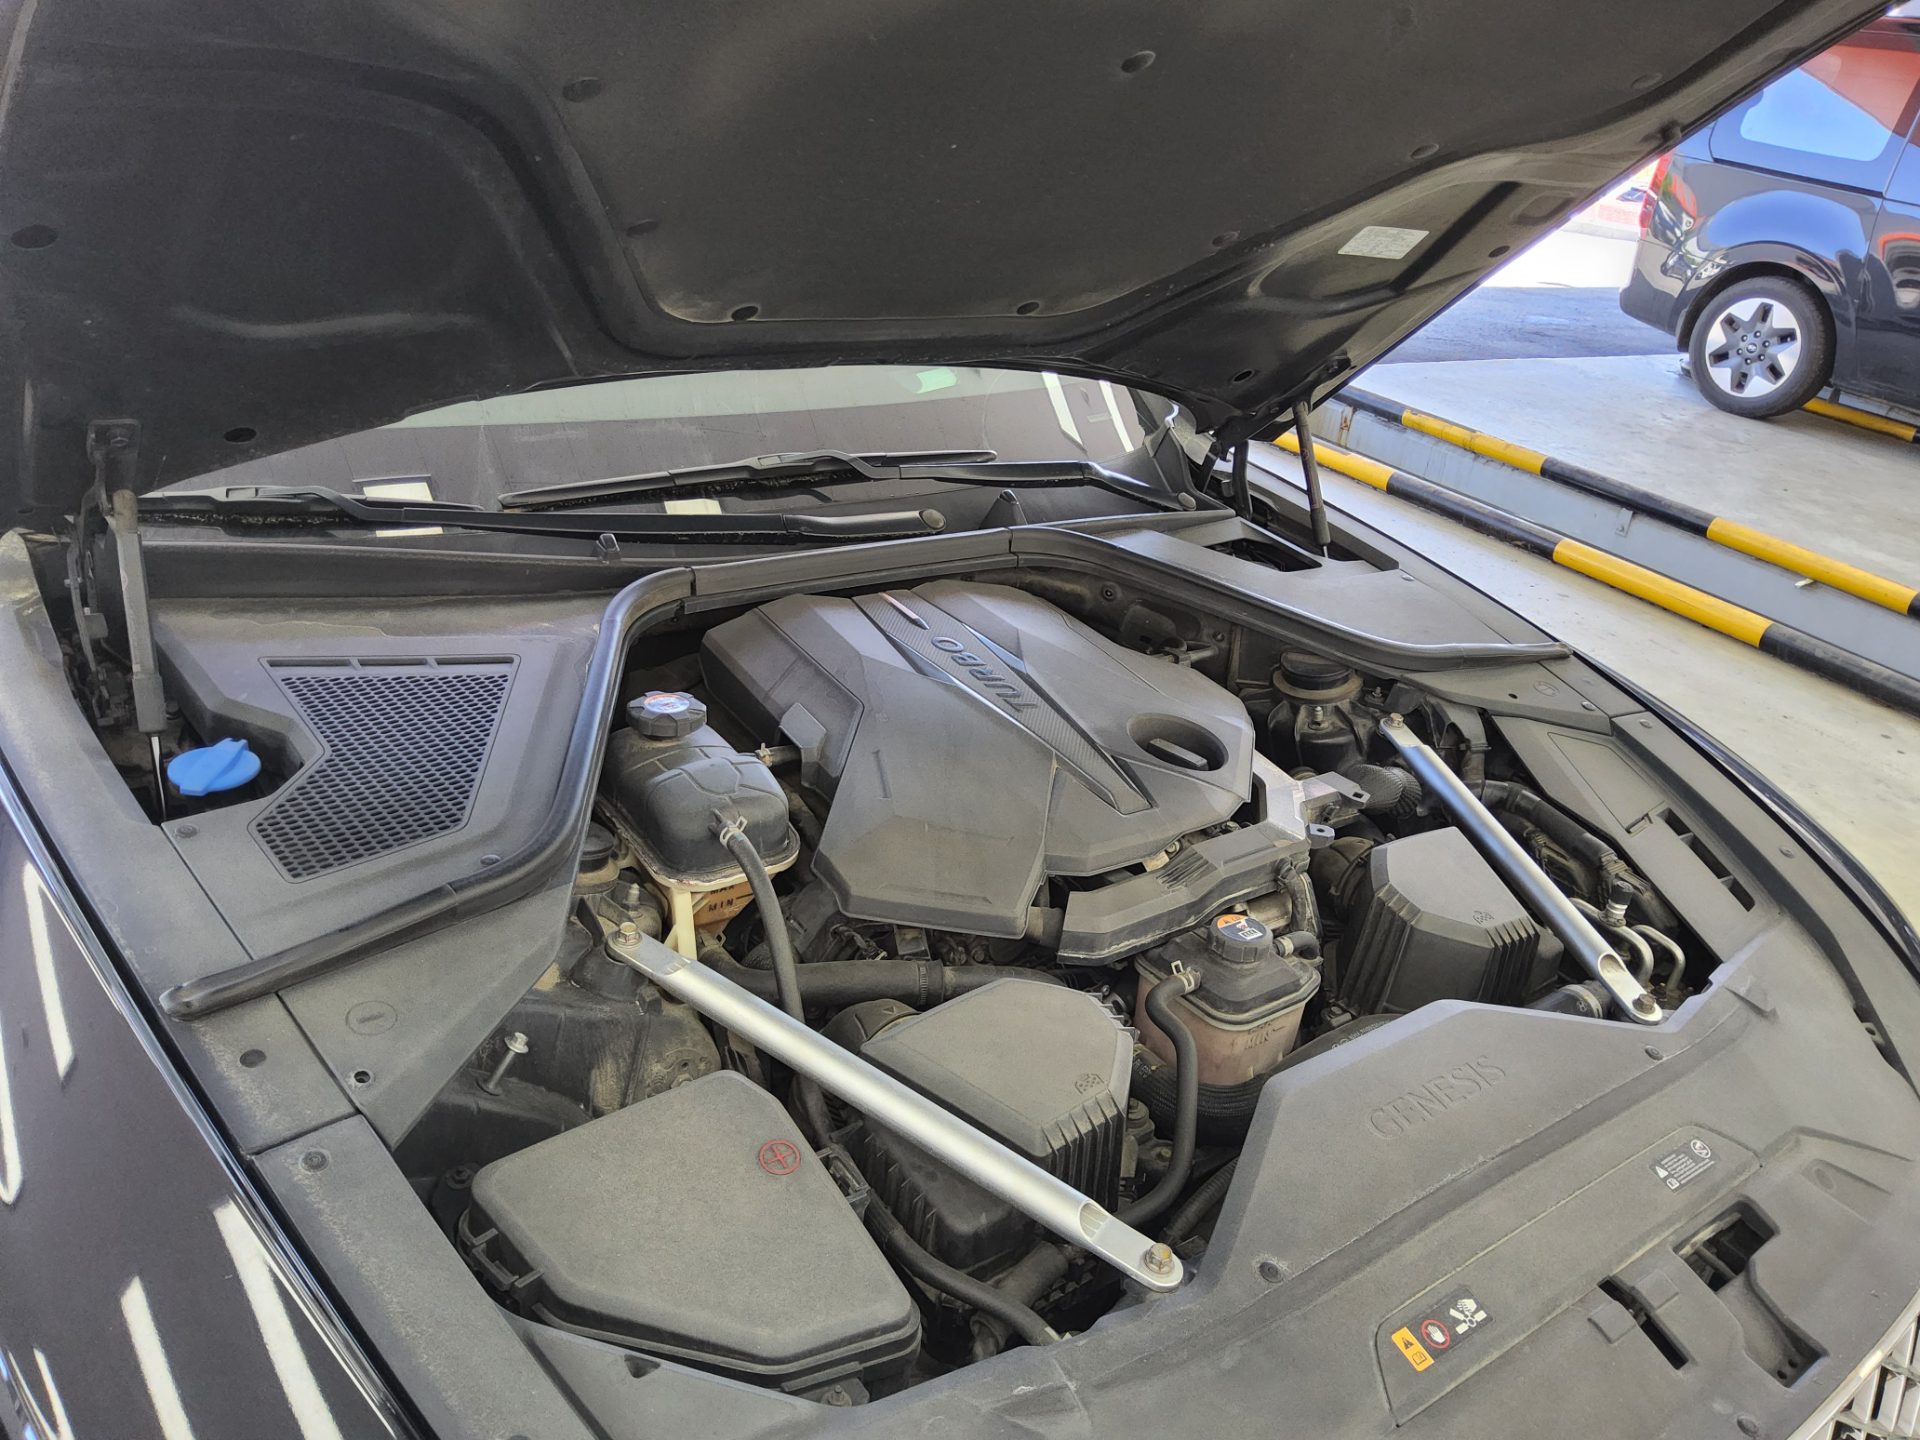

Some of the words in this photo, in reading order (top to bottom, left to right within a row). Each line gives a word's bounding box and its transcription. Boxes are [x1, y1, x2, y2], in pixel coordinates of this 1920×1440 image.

[930, 635, 1038, 712] TURBO
[708, 898, 734, 912] MIN
[1367, 1054, 1506, 1140] GENESIS
